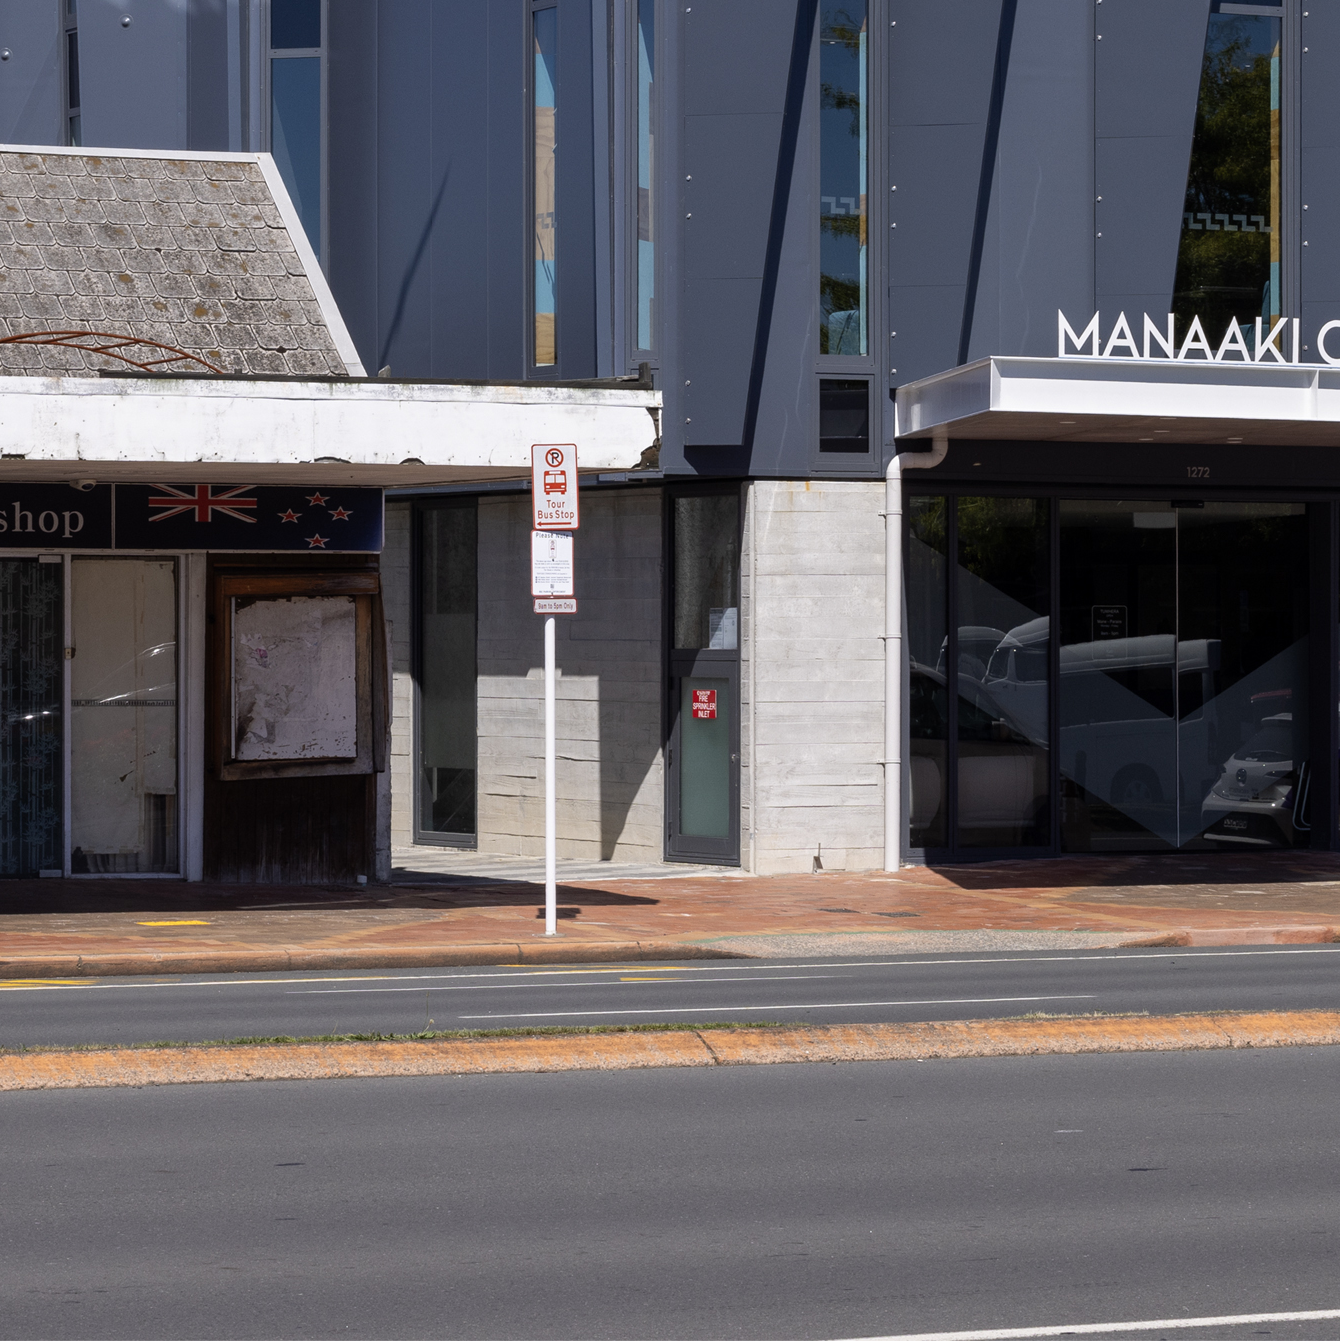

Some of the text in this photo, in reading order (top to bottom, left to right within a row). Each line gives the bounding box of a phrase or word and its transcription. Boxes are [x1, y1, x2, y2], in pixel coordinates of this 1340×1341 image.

[1058, 308, 1300, 364] MANAAKI
[1187, 466, 1210, 478] 1272
[546, 499, 565, 509] Tour
[537, 509, 575, 520] Bus Stop
[564, 602, 574, 611] Only
[692, 702, 716, 710] SPRINKLER
[698, 710, 710, 718] INLET
